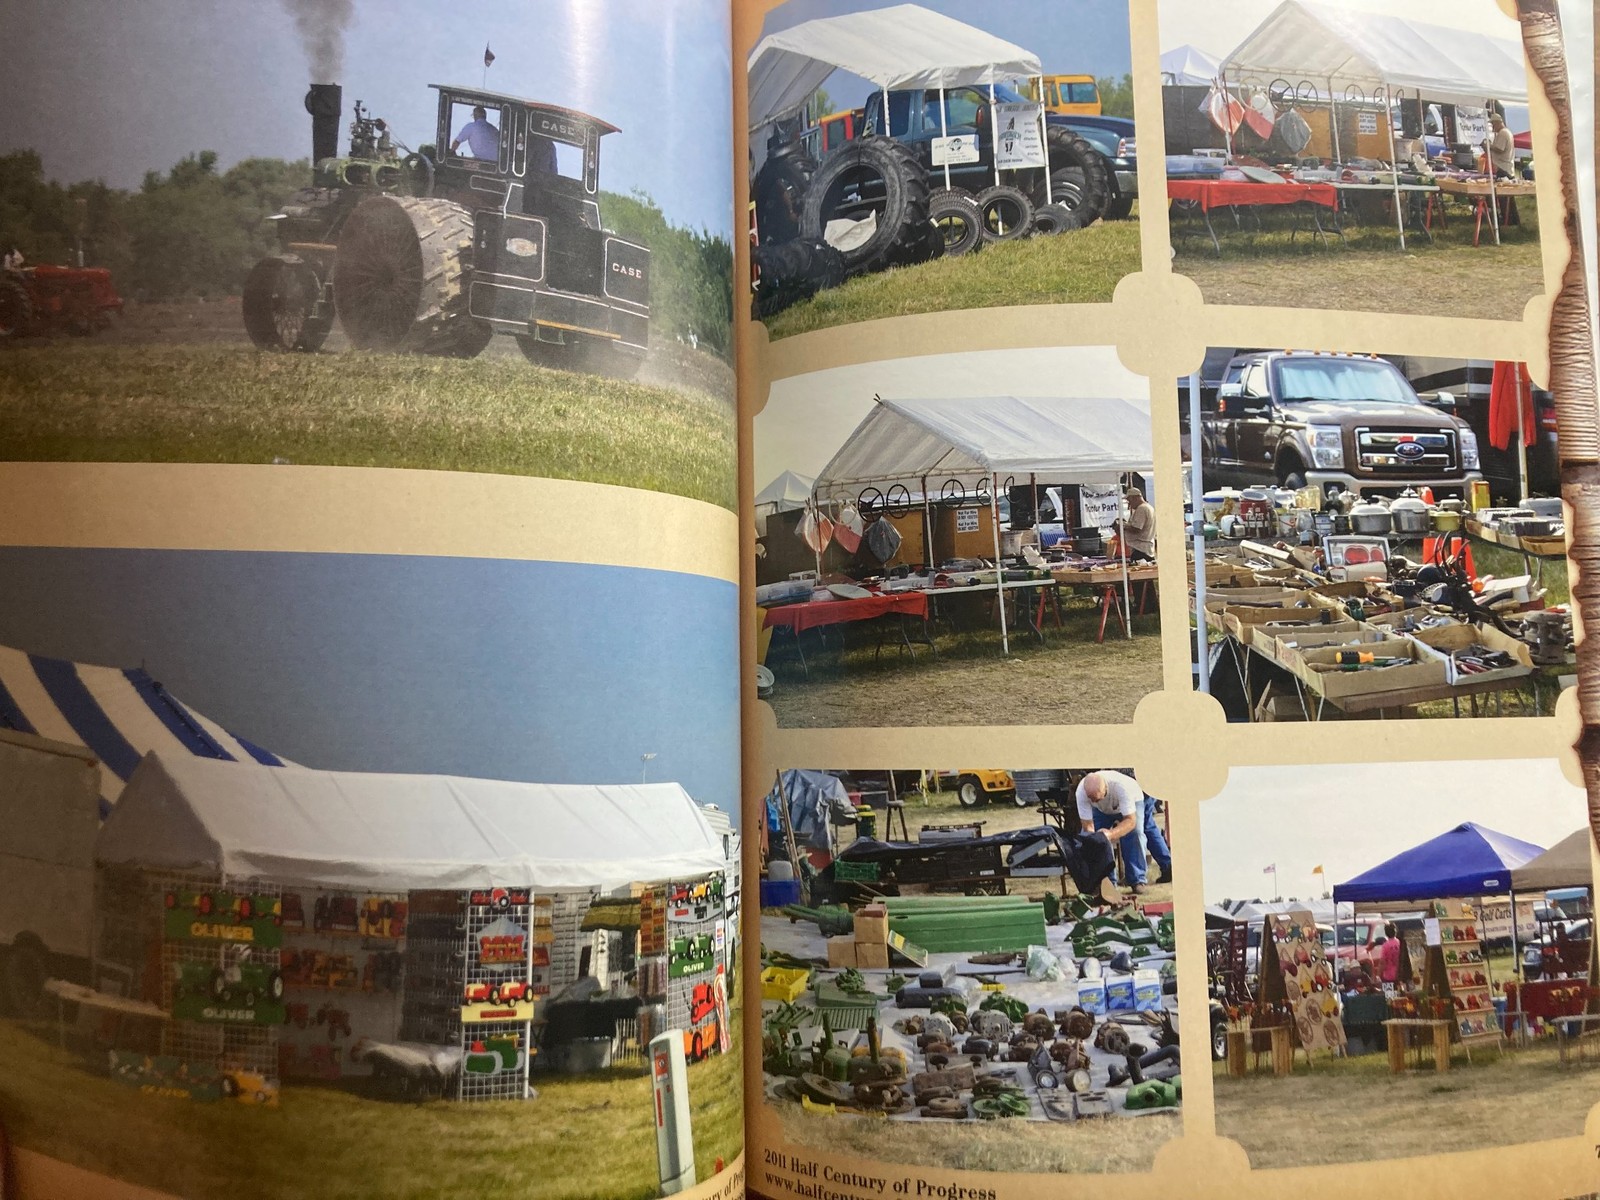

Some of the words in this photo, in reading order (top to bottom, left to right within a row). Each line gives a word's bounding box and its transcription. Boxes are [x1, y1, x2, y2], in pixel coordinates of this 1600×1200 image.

[541, 120, 576, 136] CASE
[612, 262, 642, 279] CASE
[683, 962, 705, 974] OLIVER
[764, 1148, 787, 1169] 2011
[791, 1157, 819, 1178] Half
[823, 1165, 887, 1194] Century
[893, 1178, 911, 1194] of
[917, 1179, 996, 1200] Progress
